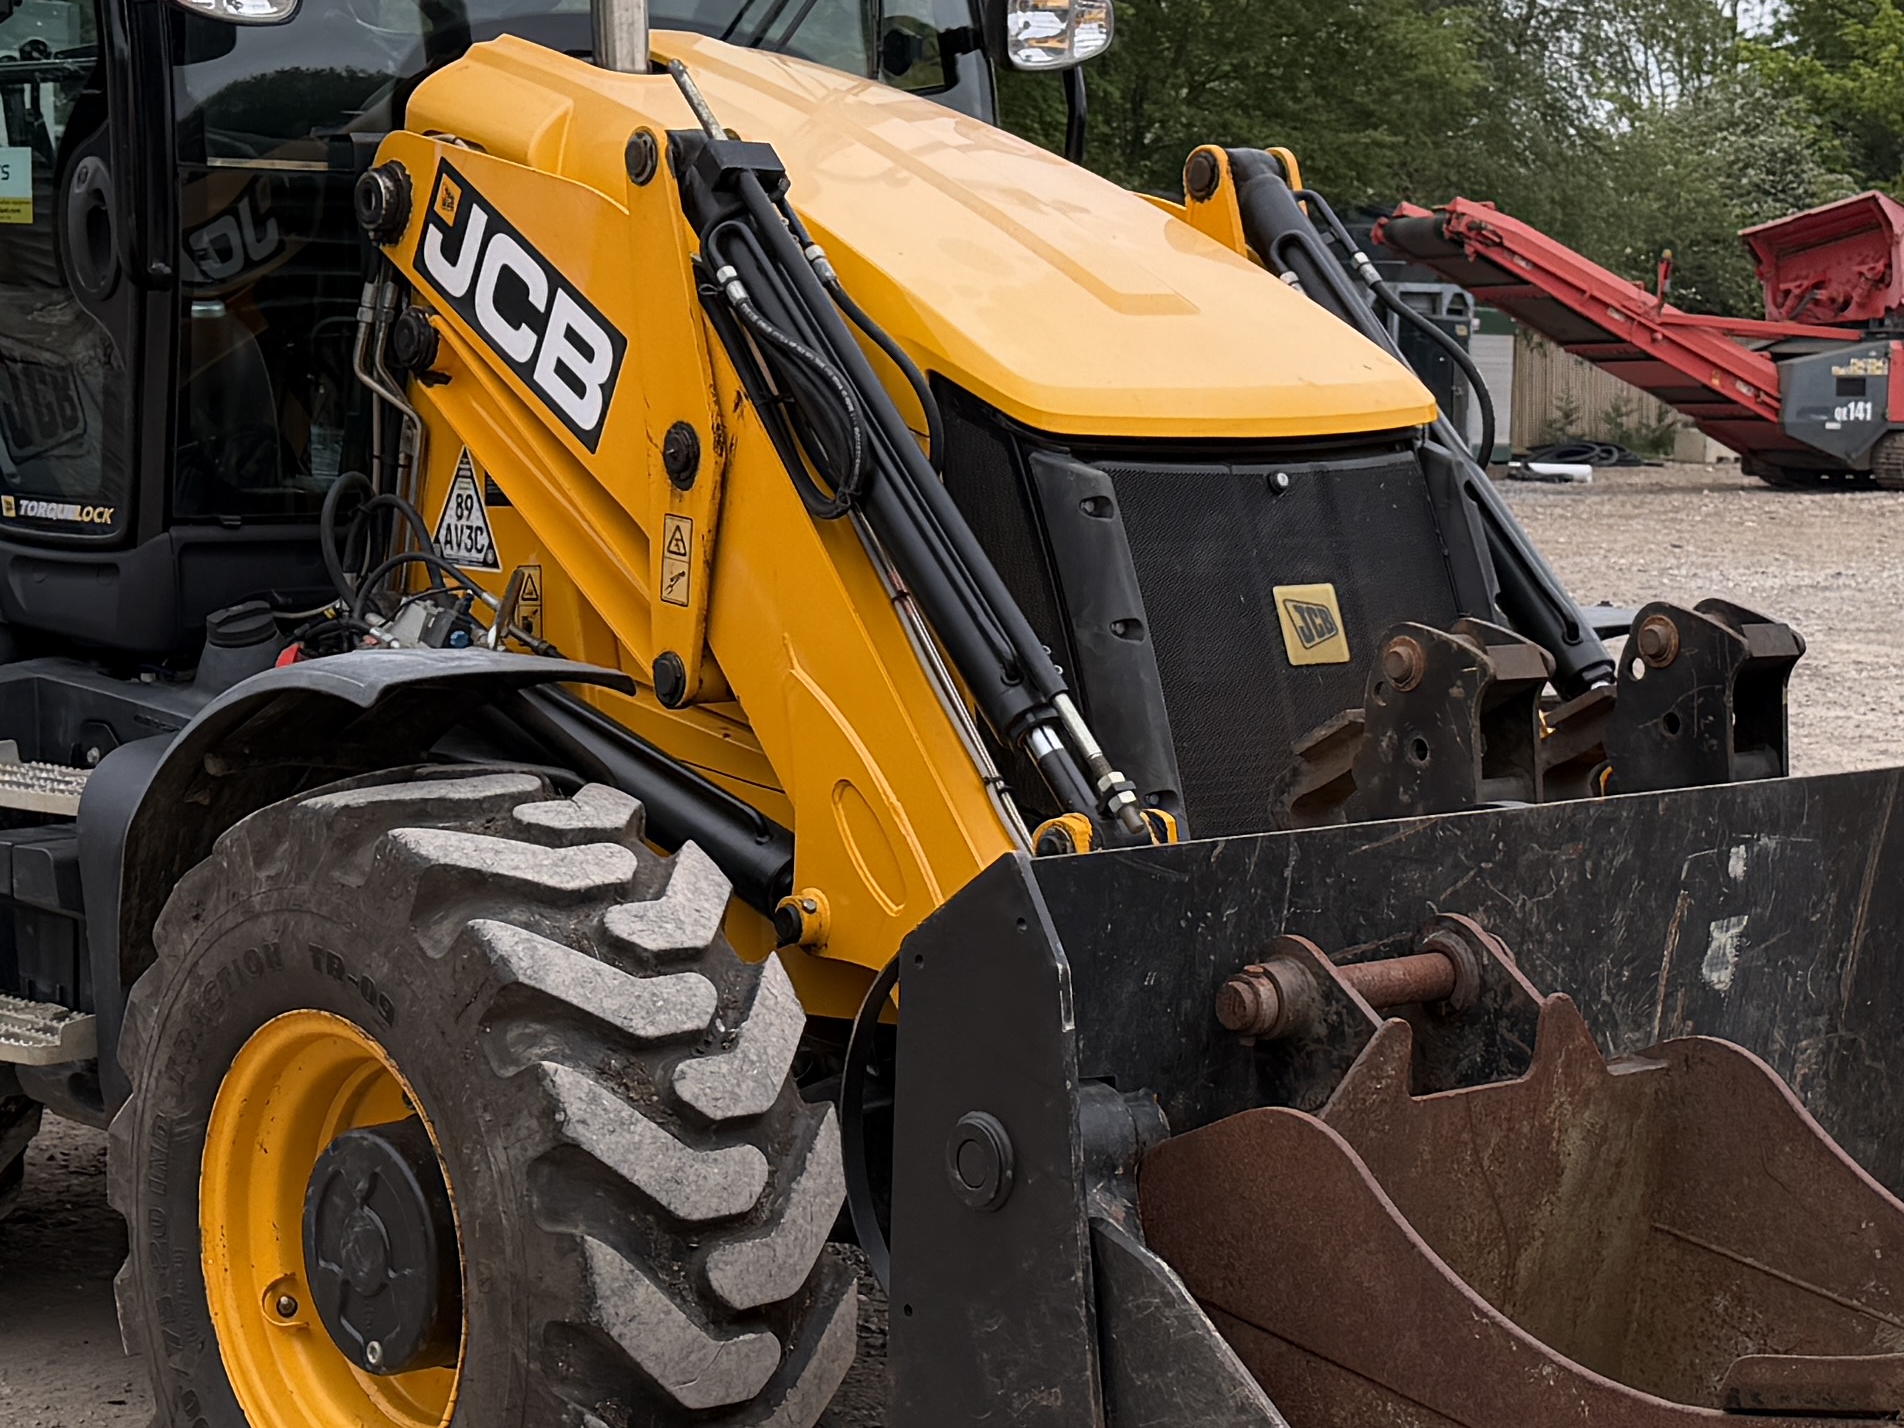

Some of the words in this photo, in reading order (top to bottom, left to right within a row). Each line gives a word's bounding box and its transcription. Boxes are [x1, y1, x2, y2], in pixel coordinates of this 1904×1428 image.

[423, 203, 614, 431] JCB
[455, 493, 474, 522] 89
[444, 522, 485, 555] AV3C
[1292, 603, 1335, 644] JCB
[308, 942, 395, 1028] TR-09
